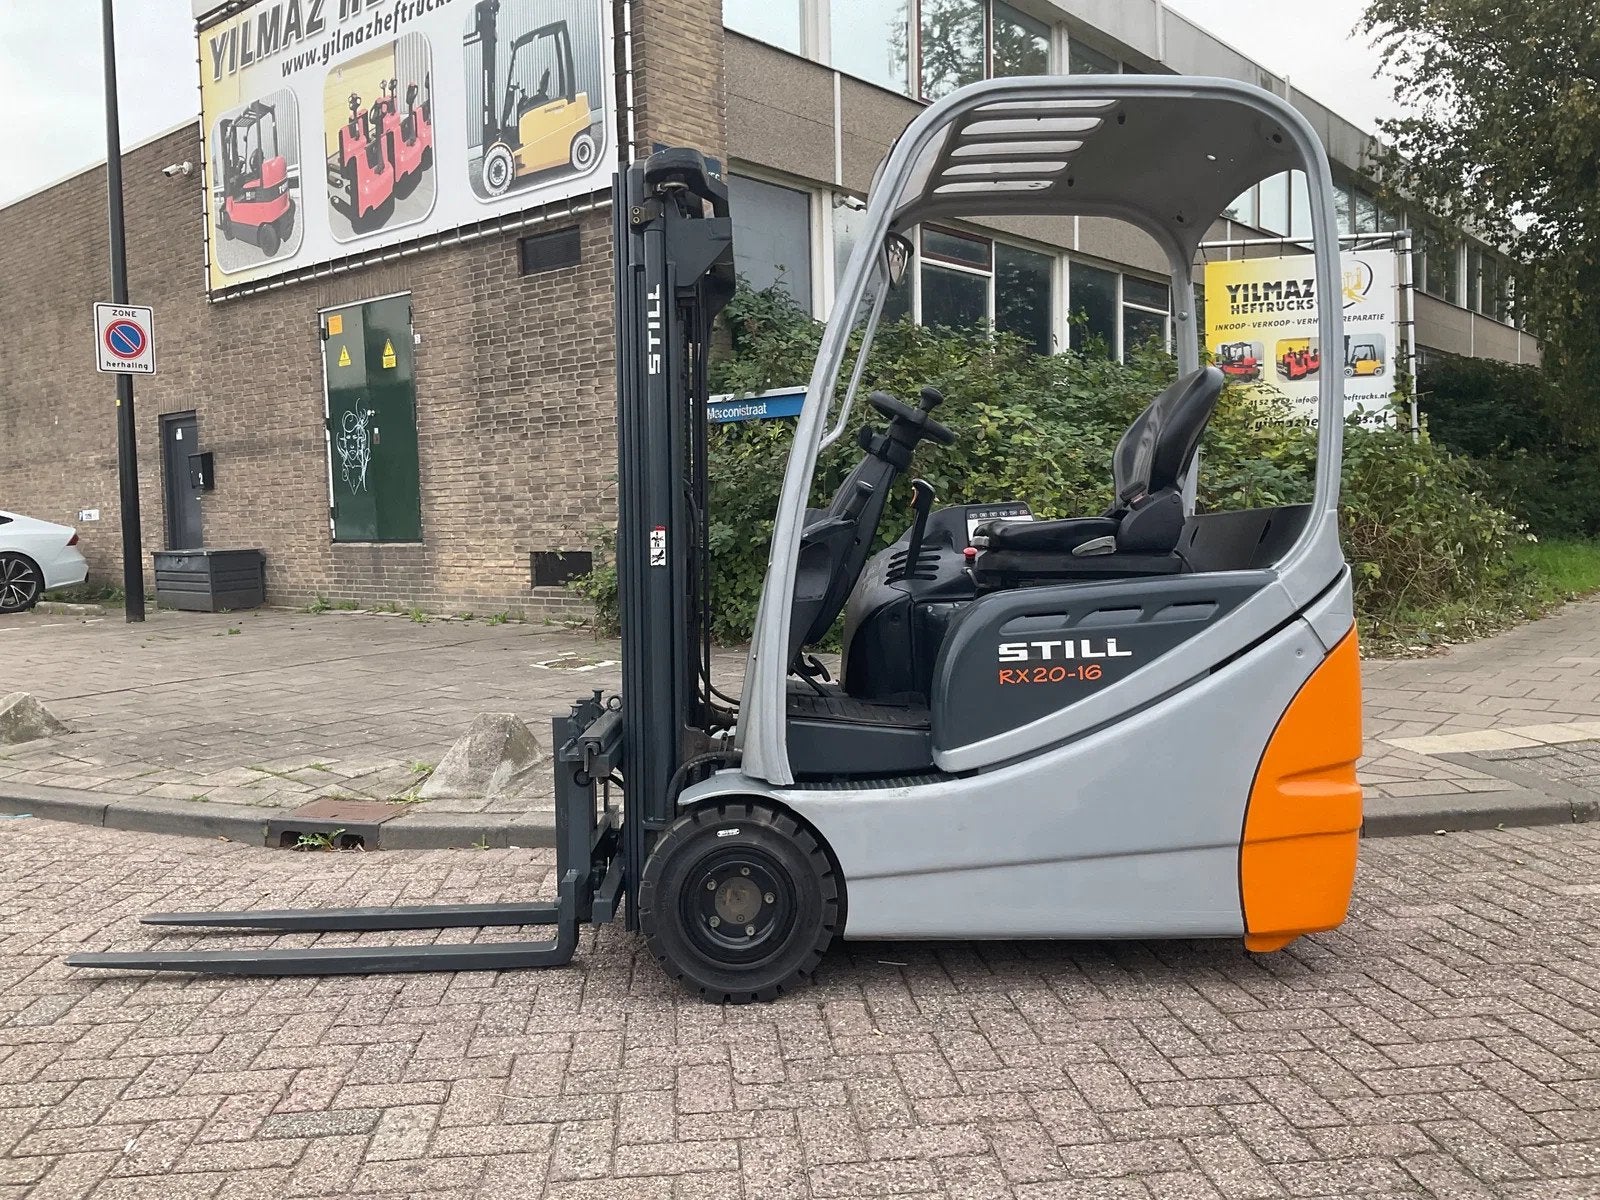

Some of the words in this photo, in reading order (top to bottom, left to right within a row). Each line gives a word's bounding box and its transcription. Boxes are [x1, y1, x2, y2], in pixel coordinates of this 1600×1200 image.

[209, 0, 326, 80] YILMAZ
[1226, 279, 1315, 303] YILMAZ
[112, 309, 137, 317] ZONE
[1230, 299, 1314, 315] HEFTRUCKS
[647, 283, 661, 375] STILL
[1215, 322, 1247, 331] INKOOP
[1252, 319, 1291, 329] VERKOOP
[1343, 313, 1385, 322] REPARATIE
[106, 361, 148, 370] herhaling
[998, 638, 1132, 662] STILL
